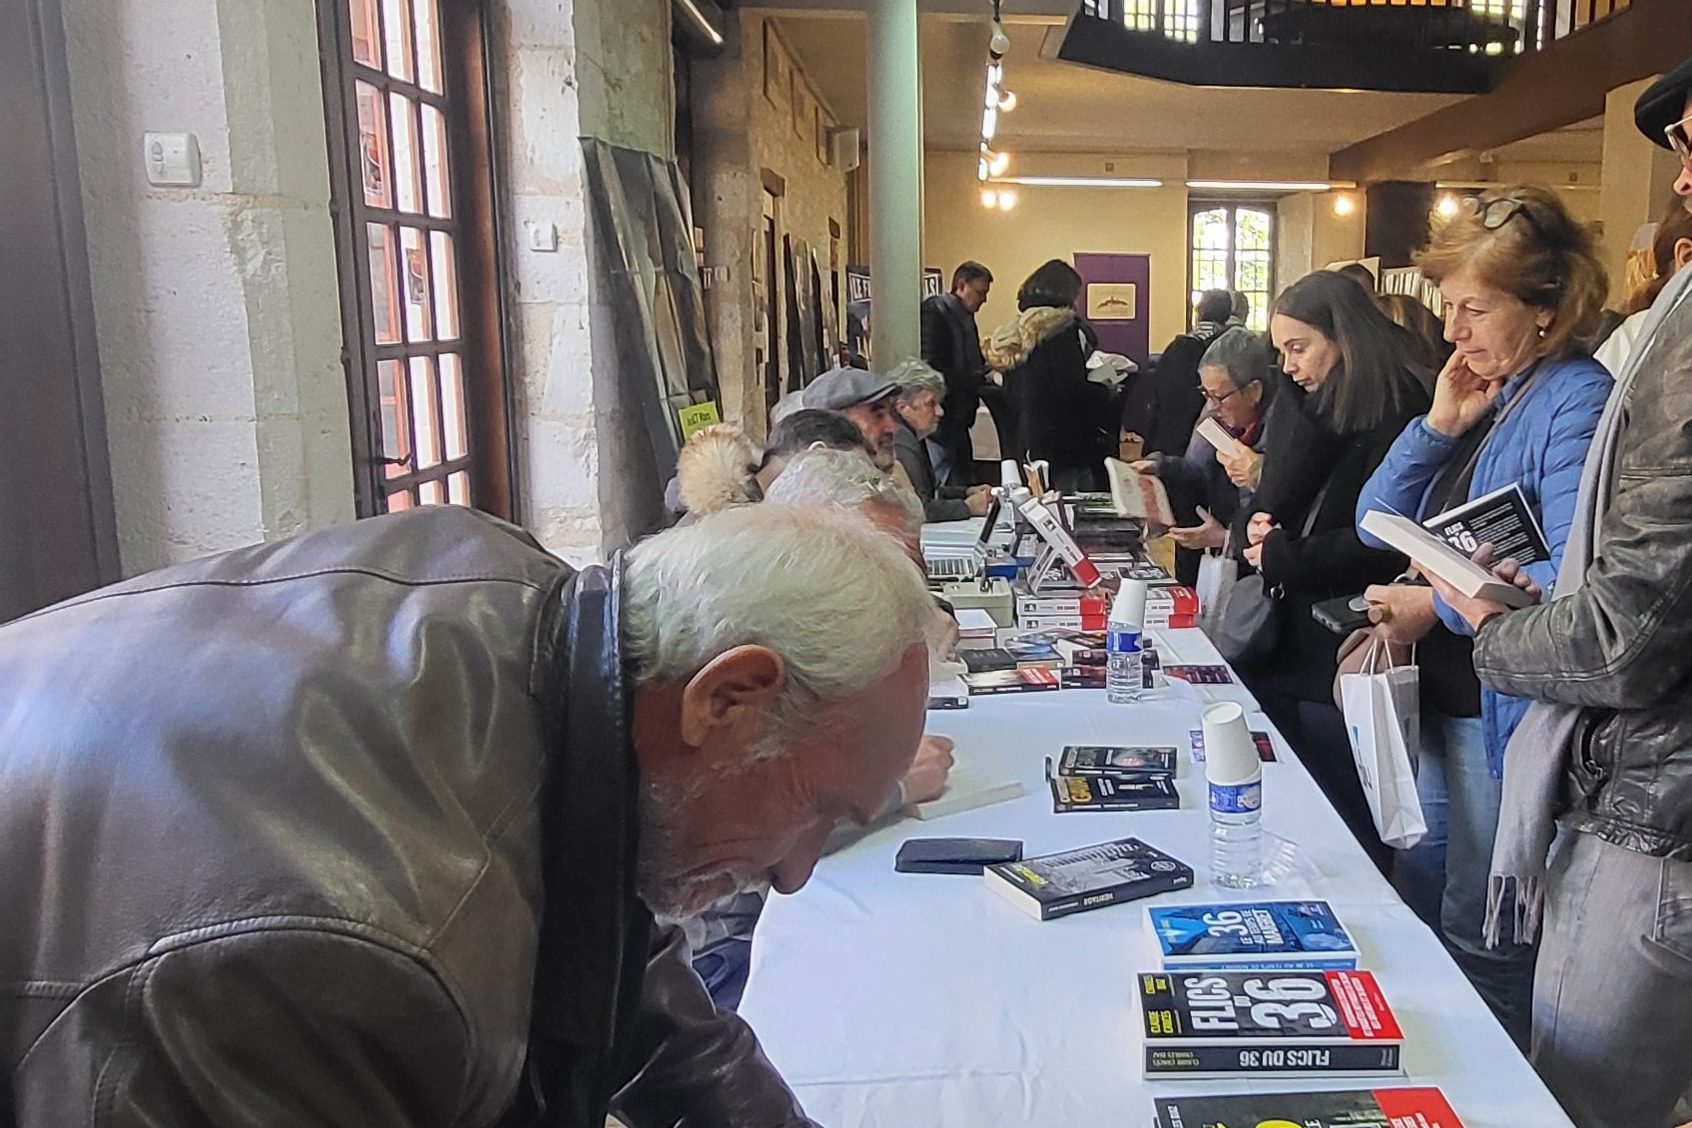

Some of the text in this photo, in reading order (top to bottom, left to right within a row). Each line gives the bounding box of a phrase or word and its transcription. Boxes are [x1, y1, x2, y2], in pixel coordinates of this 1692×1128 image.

[1203, 911, 1248, 937] 36
[1184, 977, 1239, 1030] FLICS
[1243, 978, 1337, 1029] 36
[1239, 1050, 1330, 1067] FLICS DU 36
